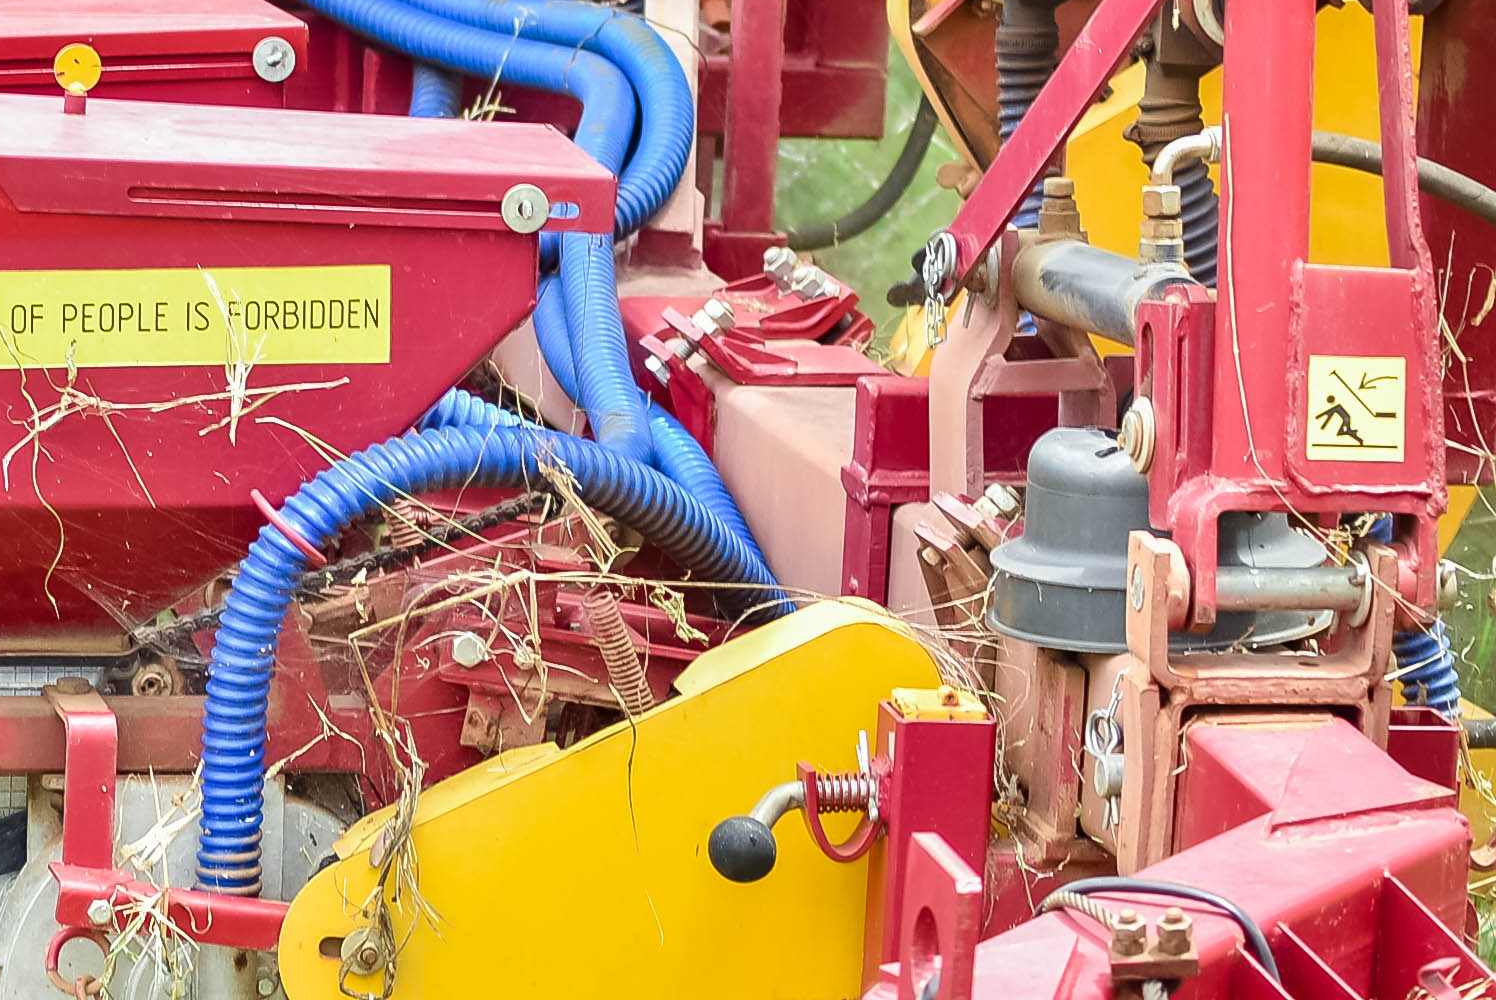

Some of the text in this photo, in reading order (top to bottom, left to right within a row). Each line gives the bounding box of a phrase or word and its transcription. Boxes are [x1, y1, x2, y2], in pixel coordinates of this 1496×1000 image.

[10, 303, 44, 335] OF
[62, 302, 169, 333] PEOPLE
[186, 301, 210, 332] IS
[228, 298, 380, 330] FORBIDDEN
